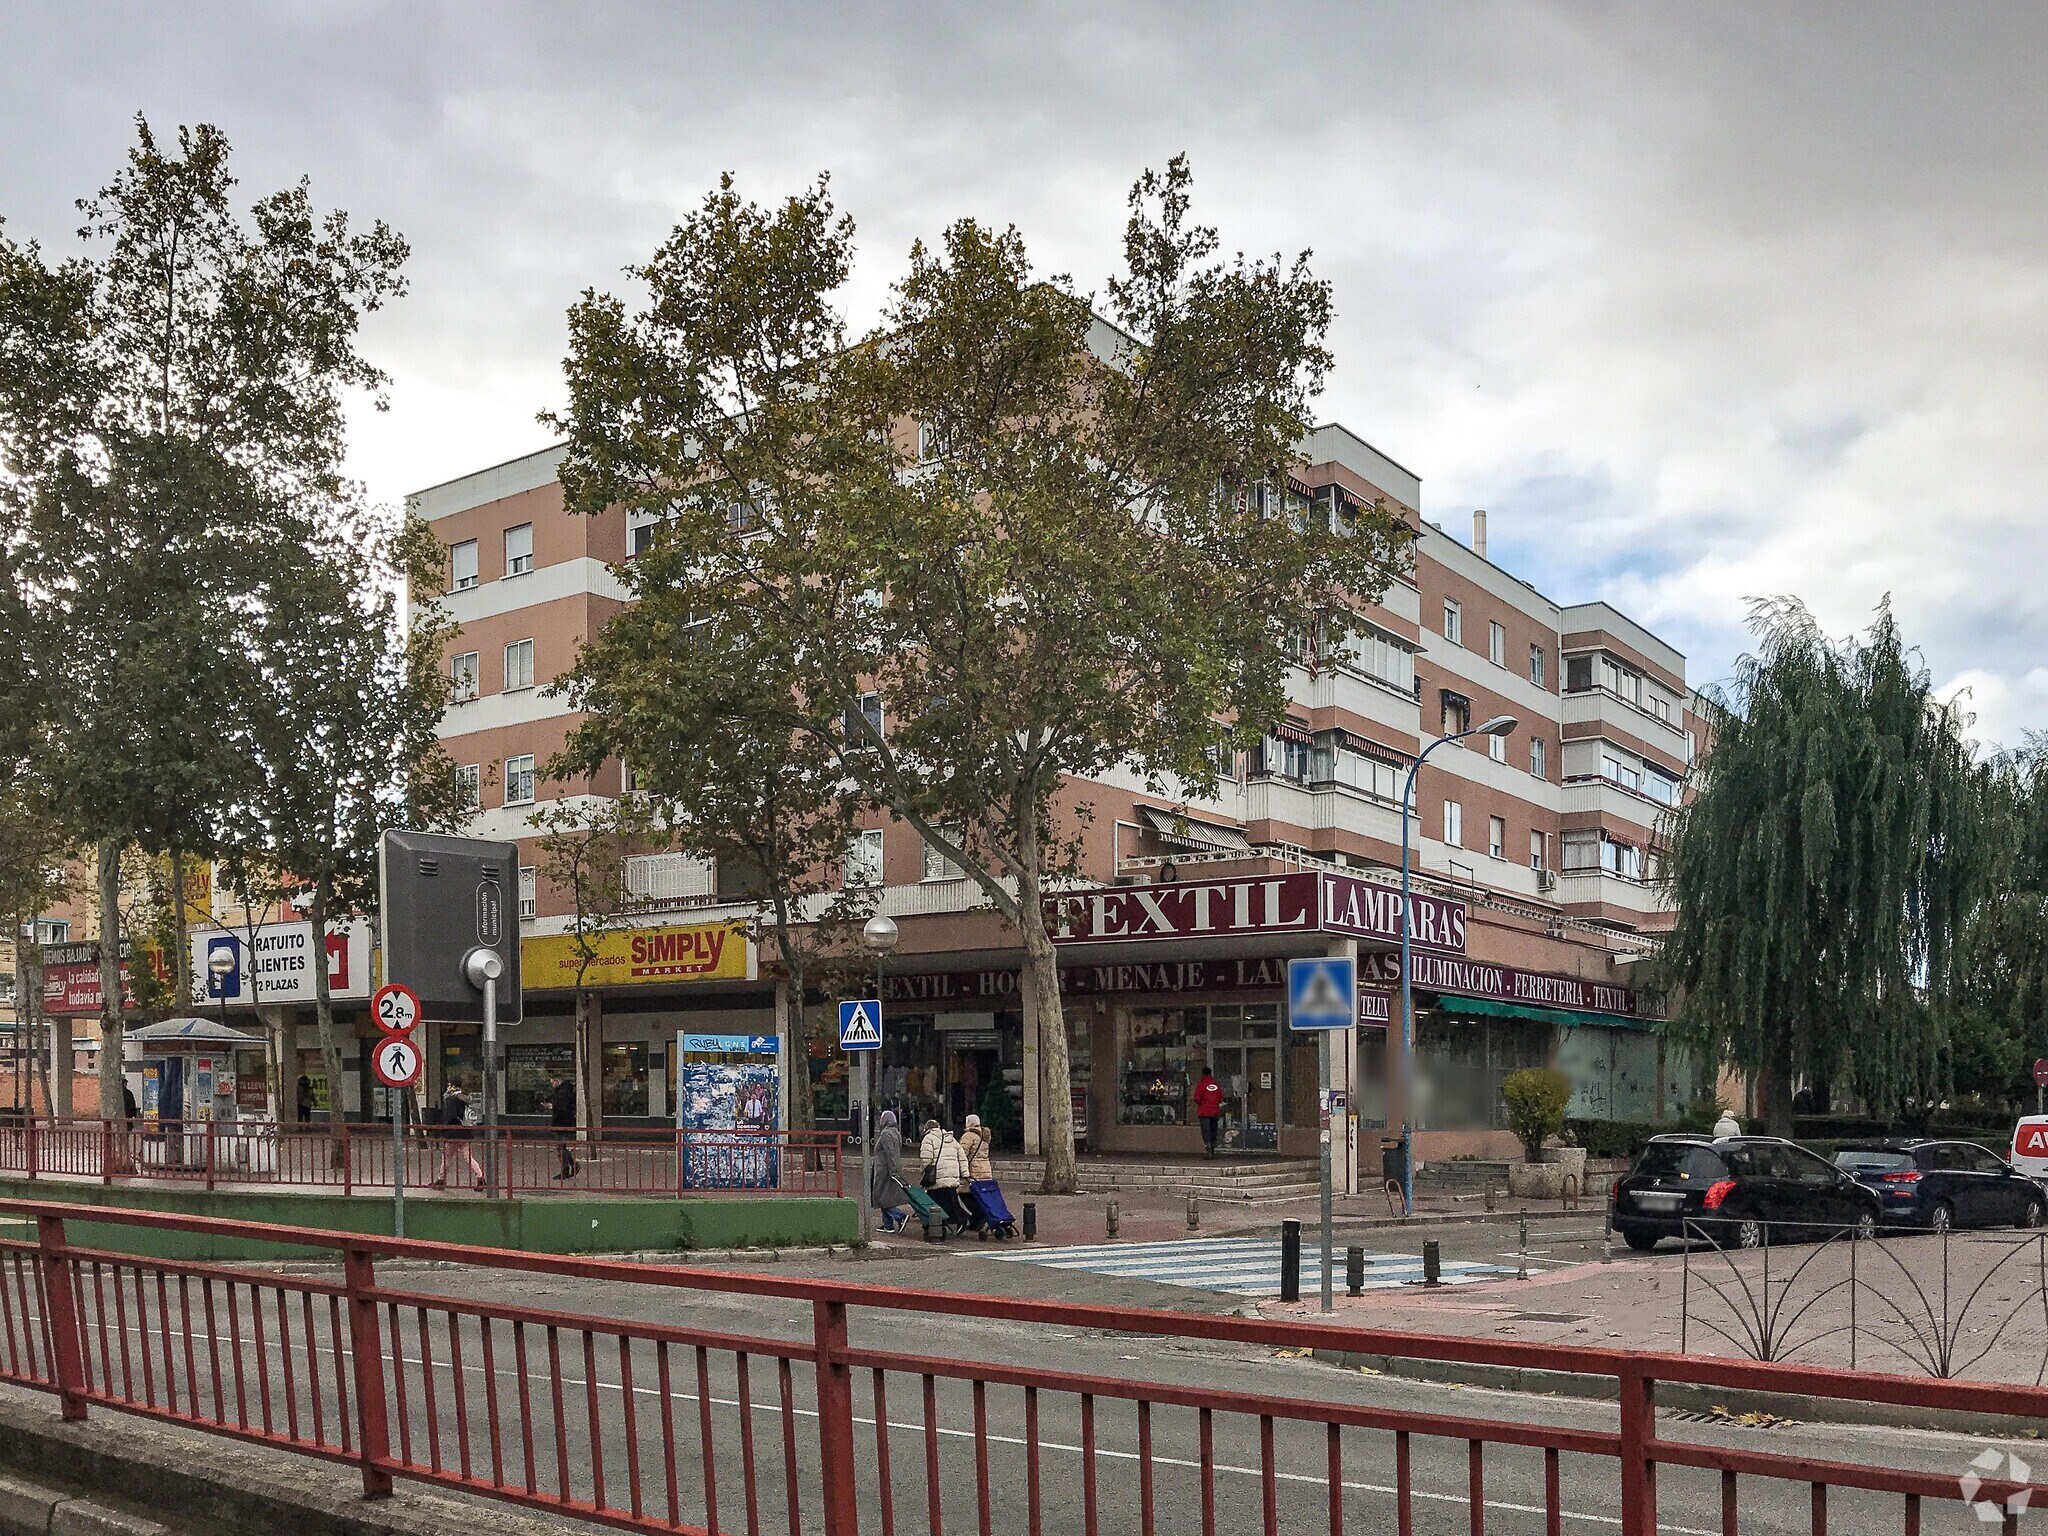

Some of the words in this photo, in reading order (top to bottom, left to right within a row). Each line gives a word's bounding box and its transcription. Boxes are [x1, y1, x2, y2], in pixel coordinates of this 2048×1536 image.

[1053, 881, 1306, 939] TEXTIL
[1325, 880, 1465, 949] LAMPARAS
[265, 978, 299, 991] PLAZAS
[642, 965, 704, 976] MARKET
[1094, 962, 1205, 991] MENAJE
[1411, 955, 1504, 994] ILUMINACION
[1514, 972, 1584, 1005] FERRETERIA
[1593, 985, 1628, 1011] TEXTIL
[1360, 995, 1389, 1017] TELUX
